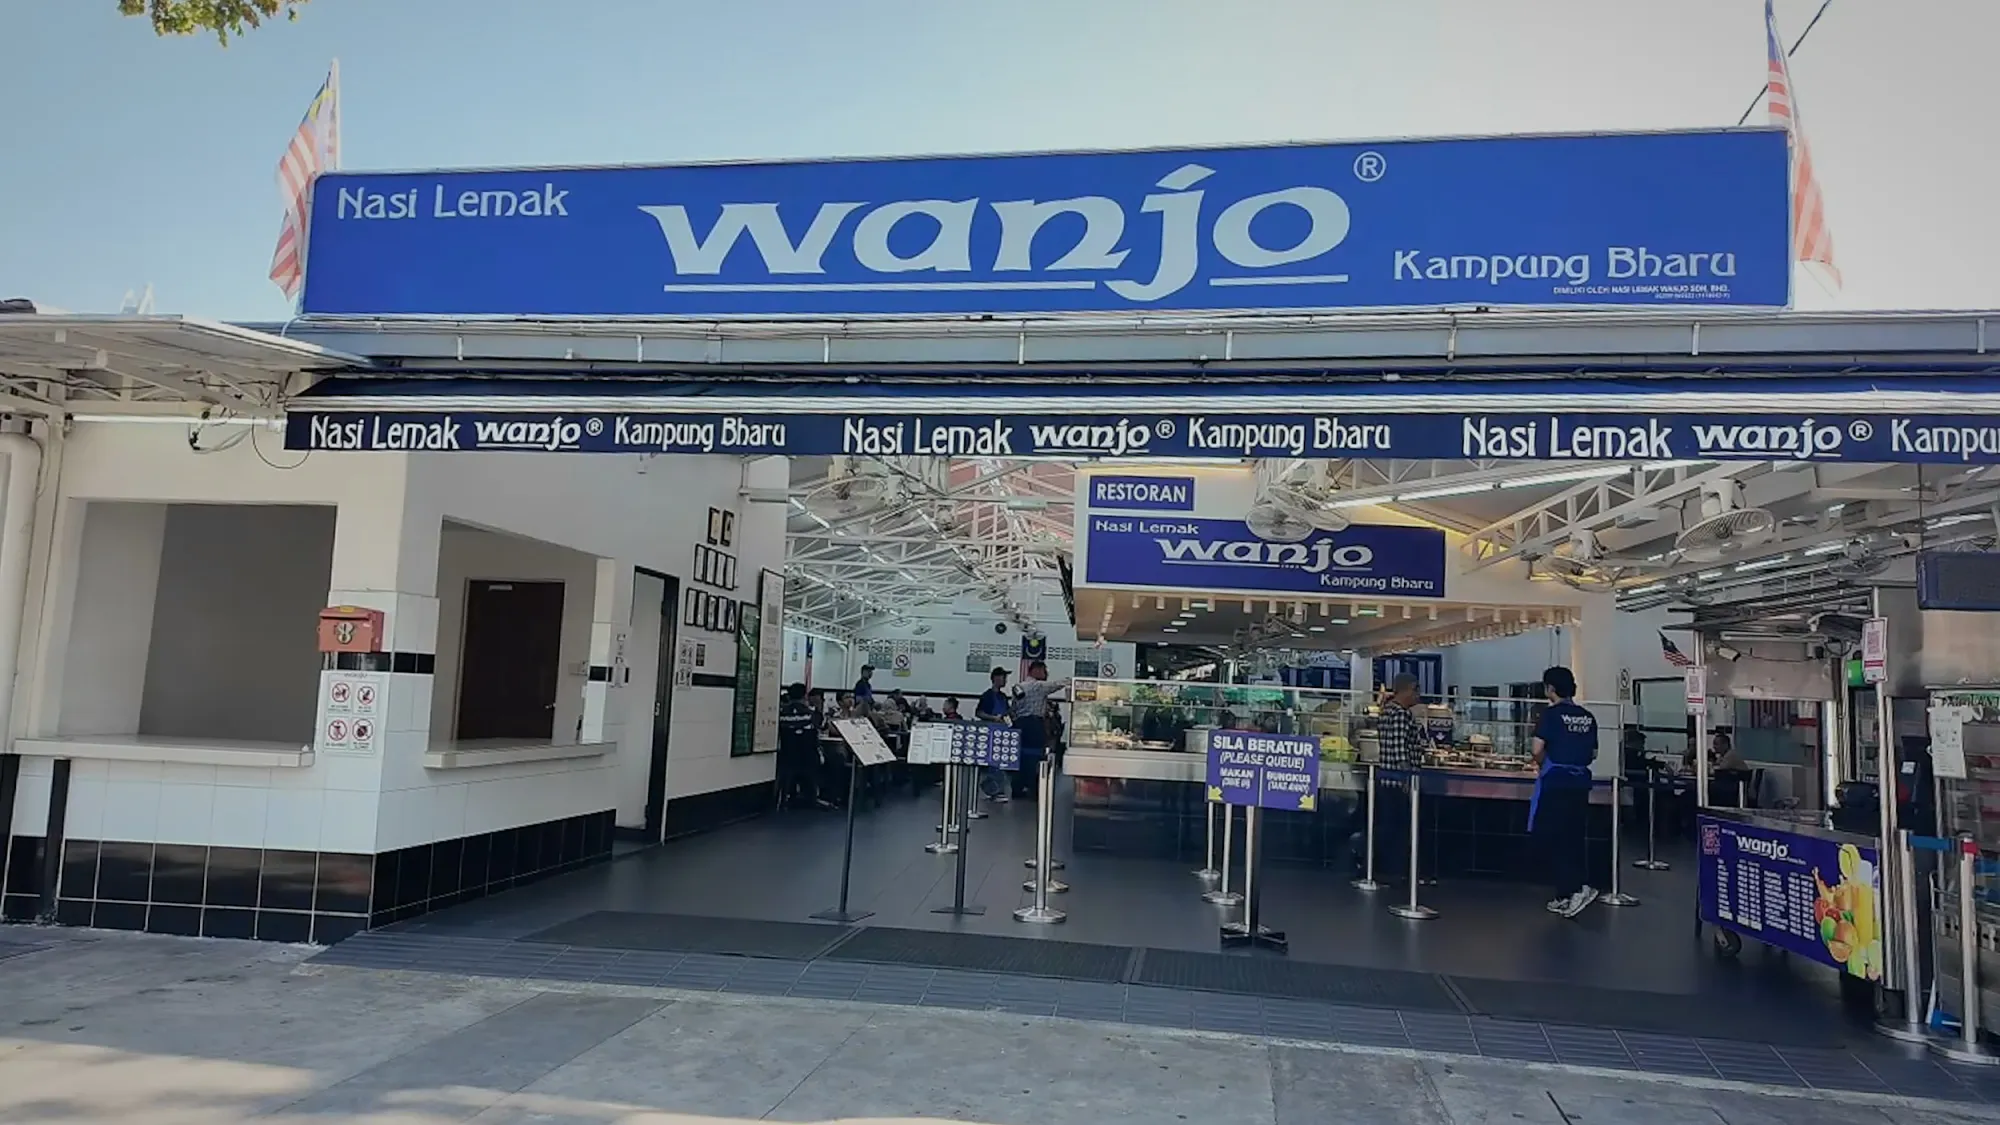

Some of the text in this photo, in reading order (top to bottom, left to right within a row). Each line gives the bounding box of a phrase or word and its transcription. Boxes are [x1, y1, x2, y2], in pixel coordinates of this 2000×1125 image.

[337, 183, 569, 219] Nasi Lemak
[638, 163, 1351, 302] wanjo
[1394, 247, 1737, 285] Kampung Bharu
[310, 415, 364, 449] Nasi
[371, 416, 461, 450] Lemak
[474, 416, 582, 451] wanjo
[615, 417, 715, 452] Kampung
[721, 417, 786, 446] Bharu
[843, 417, 904, 454] Nasi
[914, 417, 1013, 454] Lemak
[1029, 418, 1151, 456] wanjo
[1188, 417, 1305, 455] Kampung
[1313, 418, 1391, 449] Bharu
[1463, 416, 1537, 457] Nasi
[1551, 416, 1673, 458] Lemak
[1691, 418, 1843, 459] wanjo
[1891, 419, 2000, 461] Kampu
[1096, 482, 1186, 503] RESTORAN
[1095, 519, 1199, 535] Nasi Lemak
[1153, 537, 1374, 573] wanjo
[1320, 573, 1434, 590] Kampung Bharu
[1213, 735, 1313, 757] SILA BERATUR
[1219, 751, 1305, 771] (PLEASE QUEUE)
[1220, 767, 1254, 778] MAKAN
[1266, 771, 1311, 783] BUNGKUS
[1737, 836, 1787, 860] wanjo
